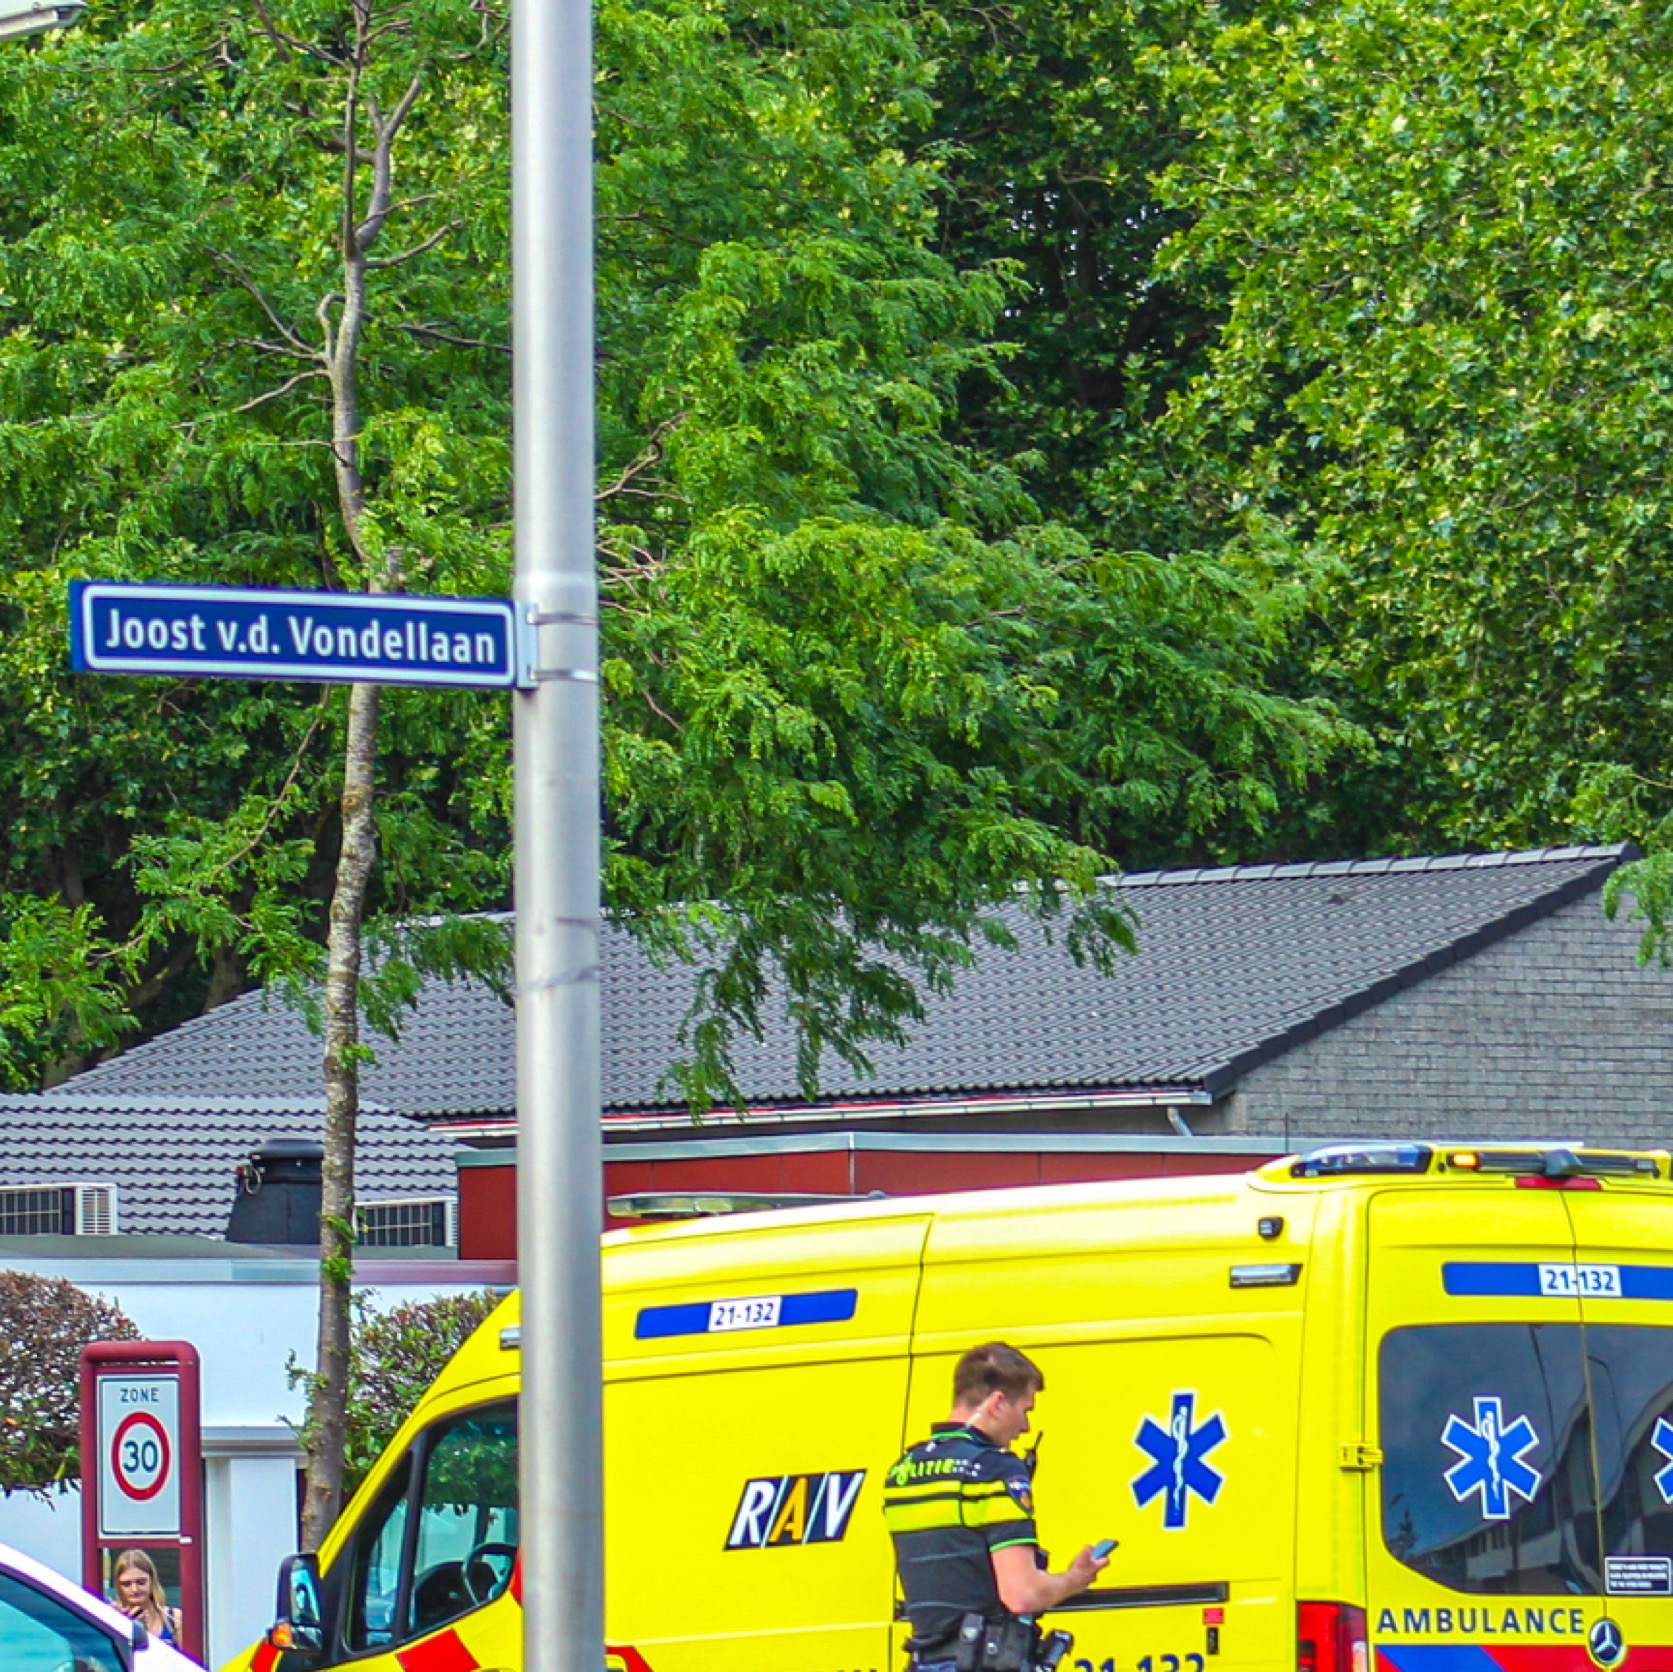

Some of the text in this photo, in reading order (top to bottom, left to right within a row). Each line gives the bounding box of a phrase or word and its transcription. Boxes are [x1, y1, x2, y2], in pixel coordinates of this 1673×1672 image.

[105, 608, 497, 665] Joost v.d. Vondellaan
[1545, 1269, 1615, 1292] 21-132
[714, 1302, 775, 1326] 21-132
[120, 1387, 160, 1402] ZONE
[123, 1439, 159, 1473] 30
[1377, 1607, 1585, 1634] AMBULANCE
